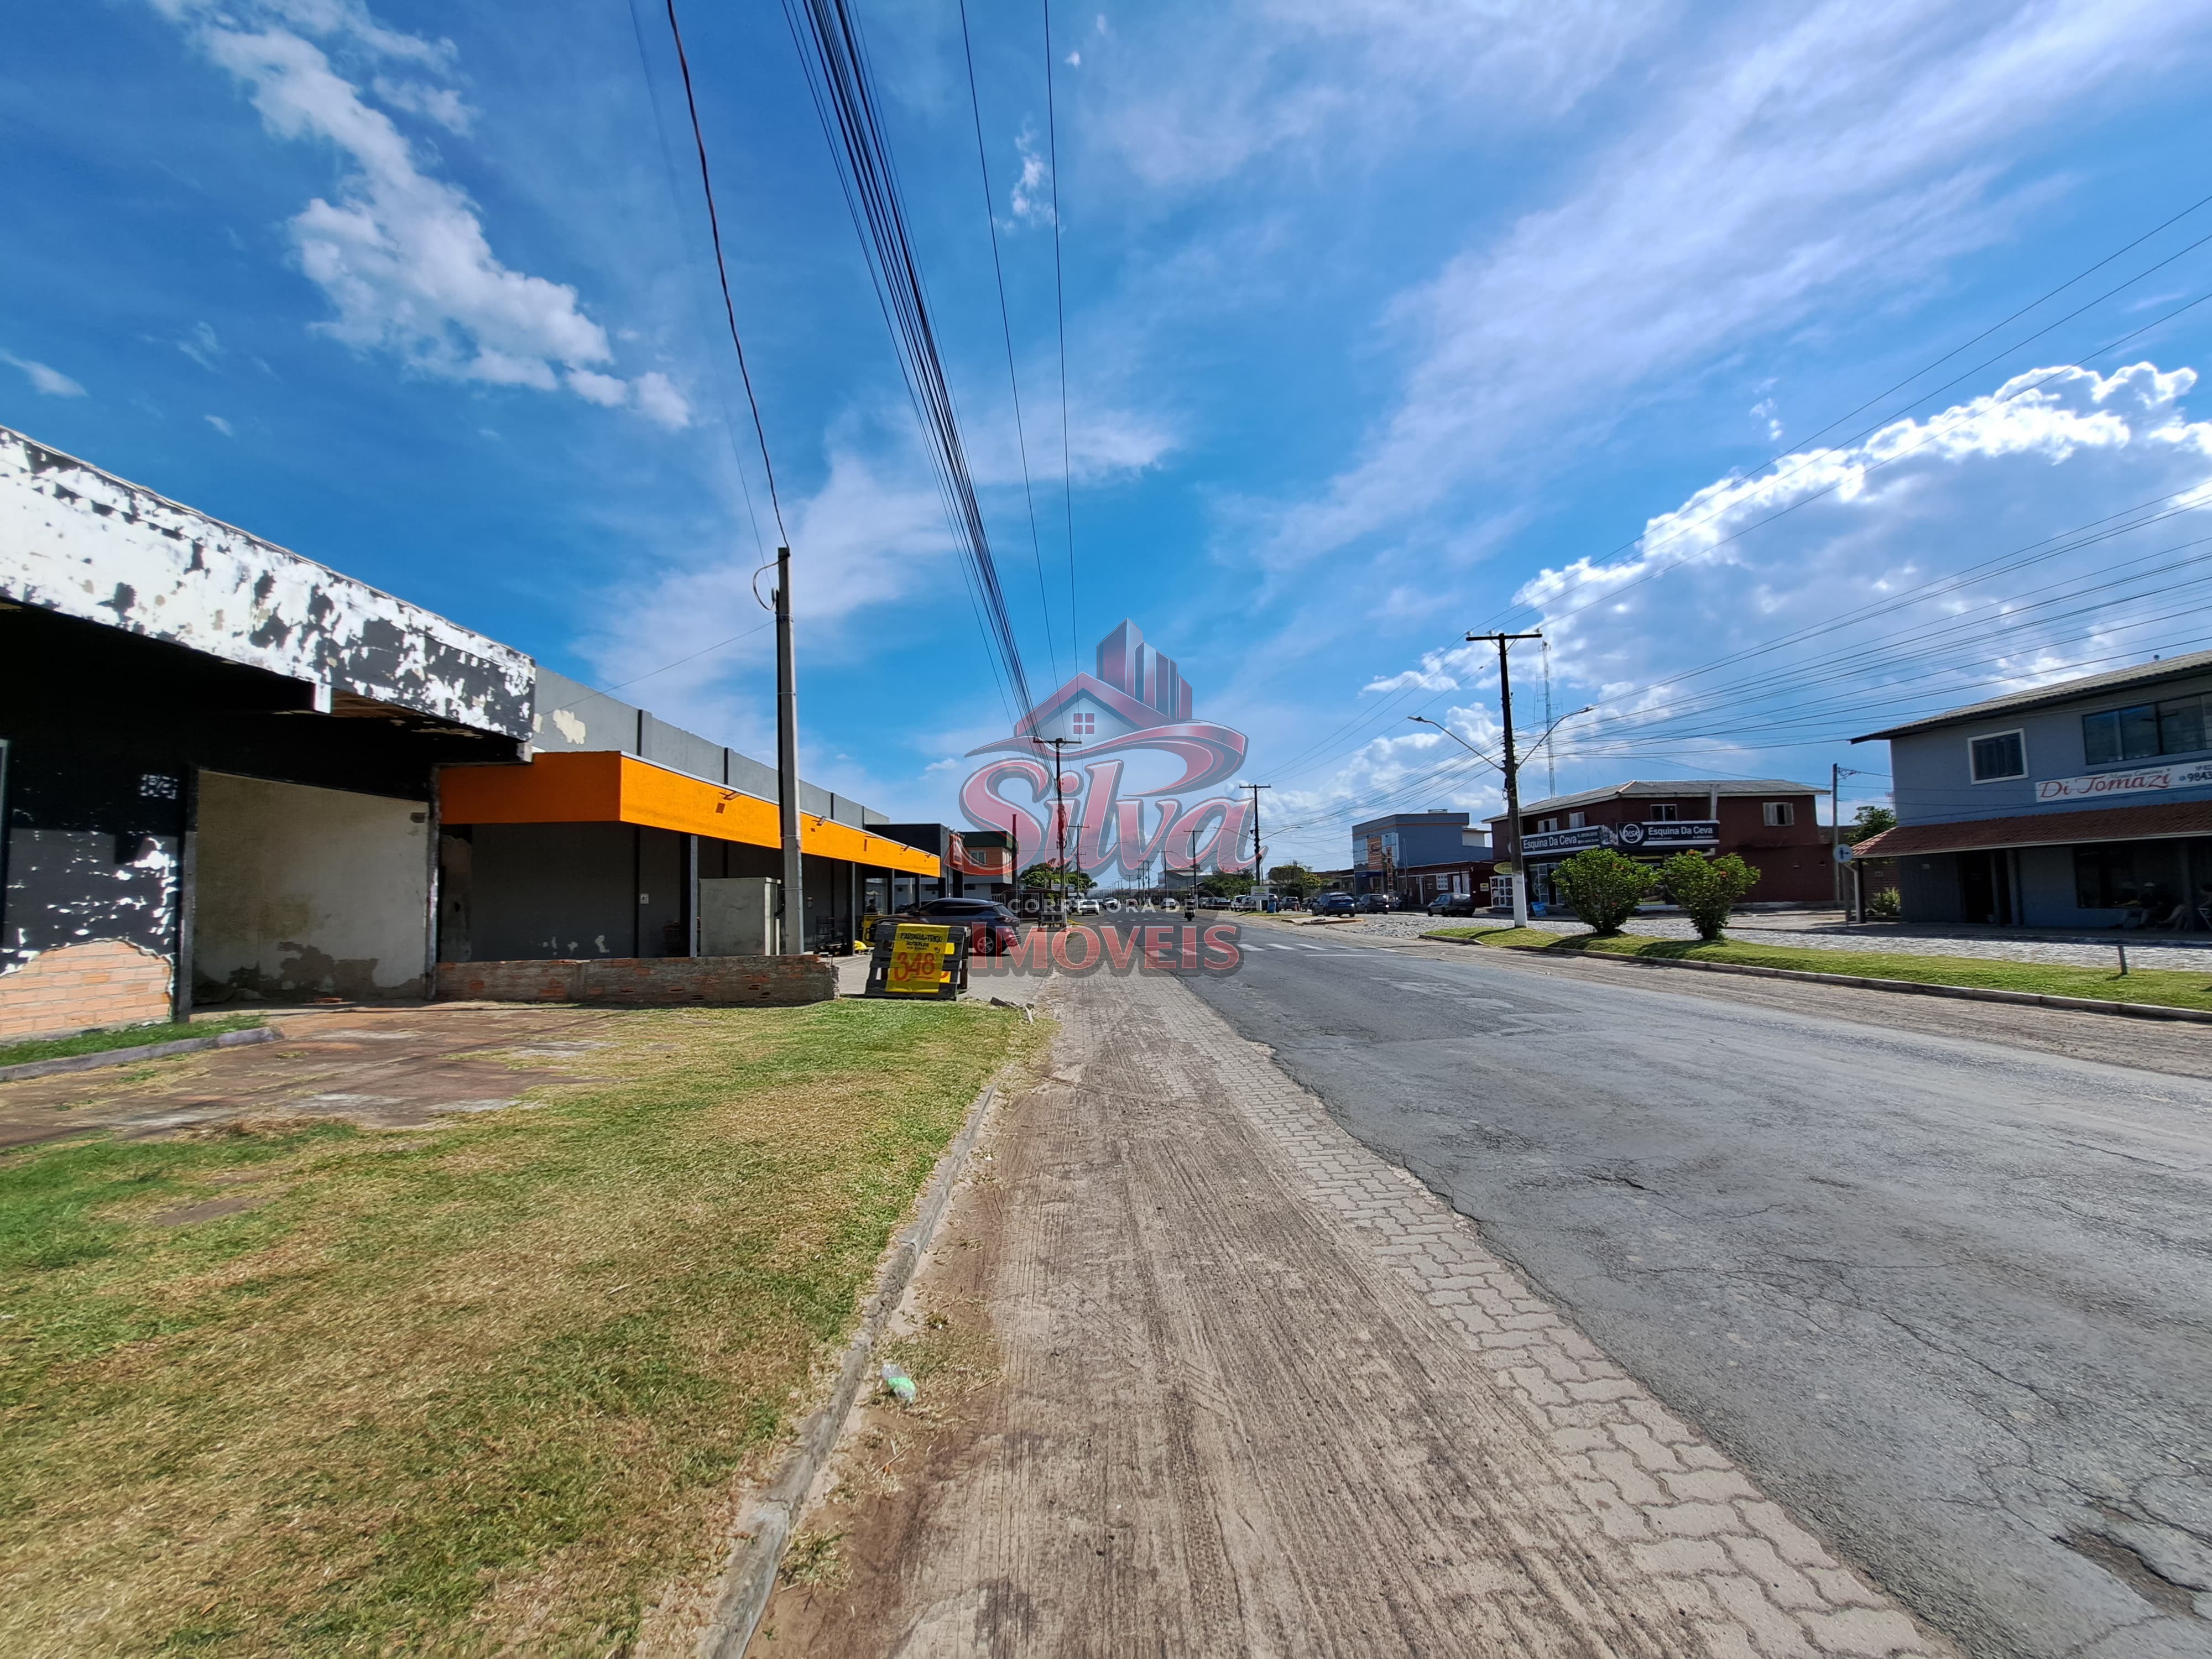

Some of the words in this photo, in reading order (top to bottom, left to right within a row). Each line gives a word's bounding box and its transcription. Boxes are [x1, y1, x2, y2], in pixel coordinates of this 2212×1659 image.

[2038, 780, 2073, 798] Di
[2075, 769, 2172, 794] Tomazi
[1648, 827, 1679, 837] Esquina
[1681, 826, 1692, 834] Da
[1693, 826, 1713, 834] Ceva
[1523, 838, 1548, 851] Esquina
[1548, 836, 1558, 847] Da
[1559, 835, 1577, 845] Ceva
